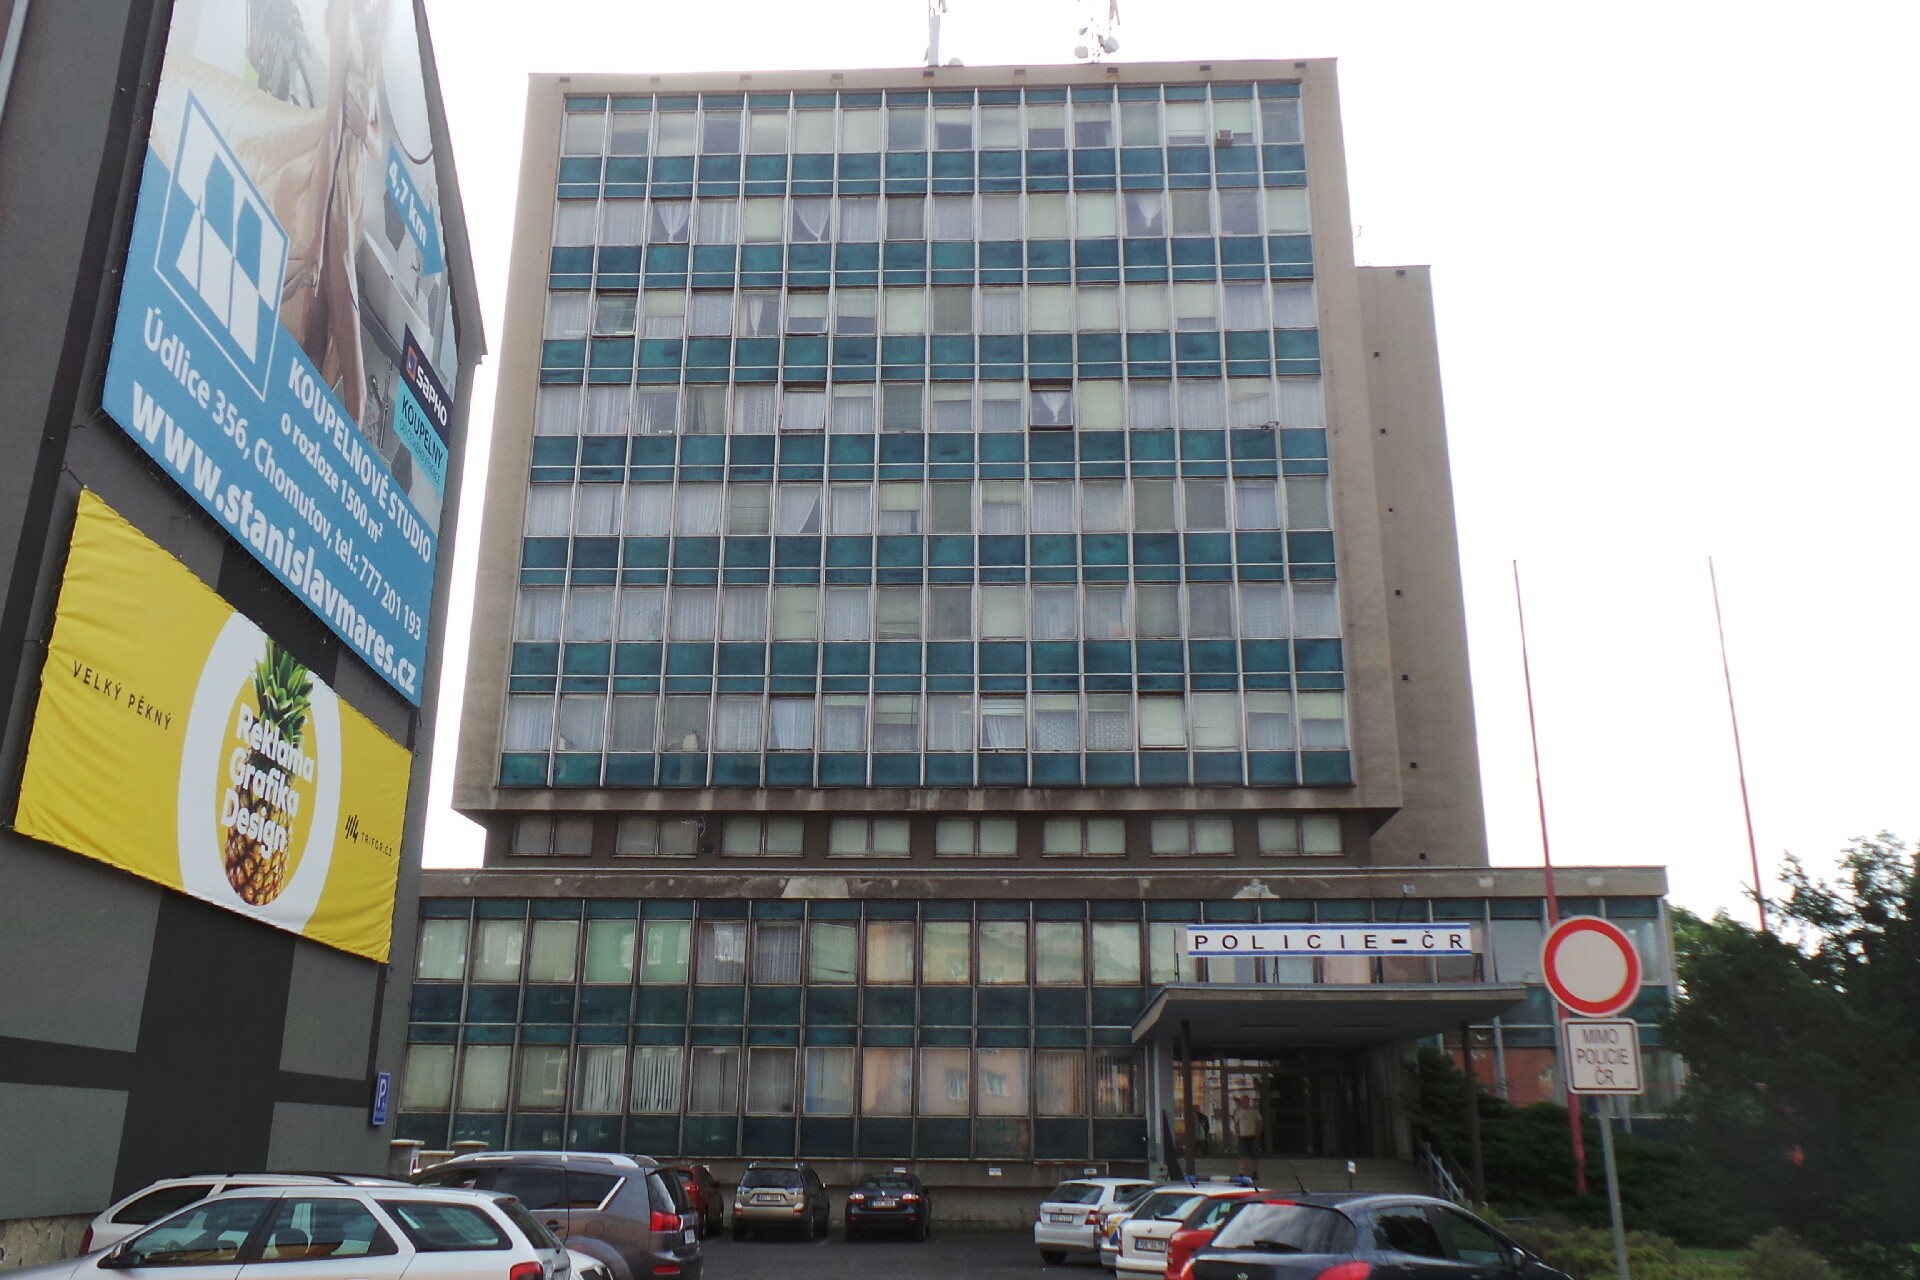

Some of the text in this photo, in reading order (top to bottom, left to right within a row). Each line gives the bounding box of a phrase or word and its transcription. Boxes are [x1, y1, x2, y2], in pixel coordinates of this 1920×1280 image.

[389, 161, 427, 247] 4,7 km
[288, 356, 431, 563] KOUPELNOVÉ STUDIO
[402, 394, 443, 469] KOUPELNY
[144, 307, 422, 641] Údlice 356, Chomutov, tel.: 777 201 193
[281, 412, 292, 436] o
[292, 424, 339, 494] rozloze
[340, 479, 370, 527] 1500
[132, 380, 417, 695] www.stanislavmares.cz
[73, 660, 172, 731] VELKÝ PĚKNÝ
[236, 702, 315, 784] Reklama
[229, 747, 299, 818] Grafika
[220, 788, 287, 859] Design
[1576, 1048, 1629, 1065] POLICIE
[1583, 1028, 1618, 1044] MIMO
[1595, 1065, 1616, 1085] ČR
